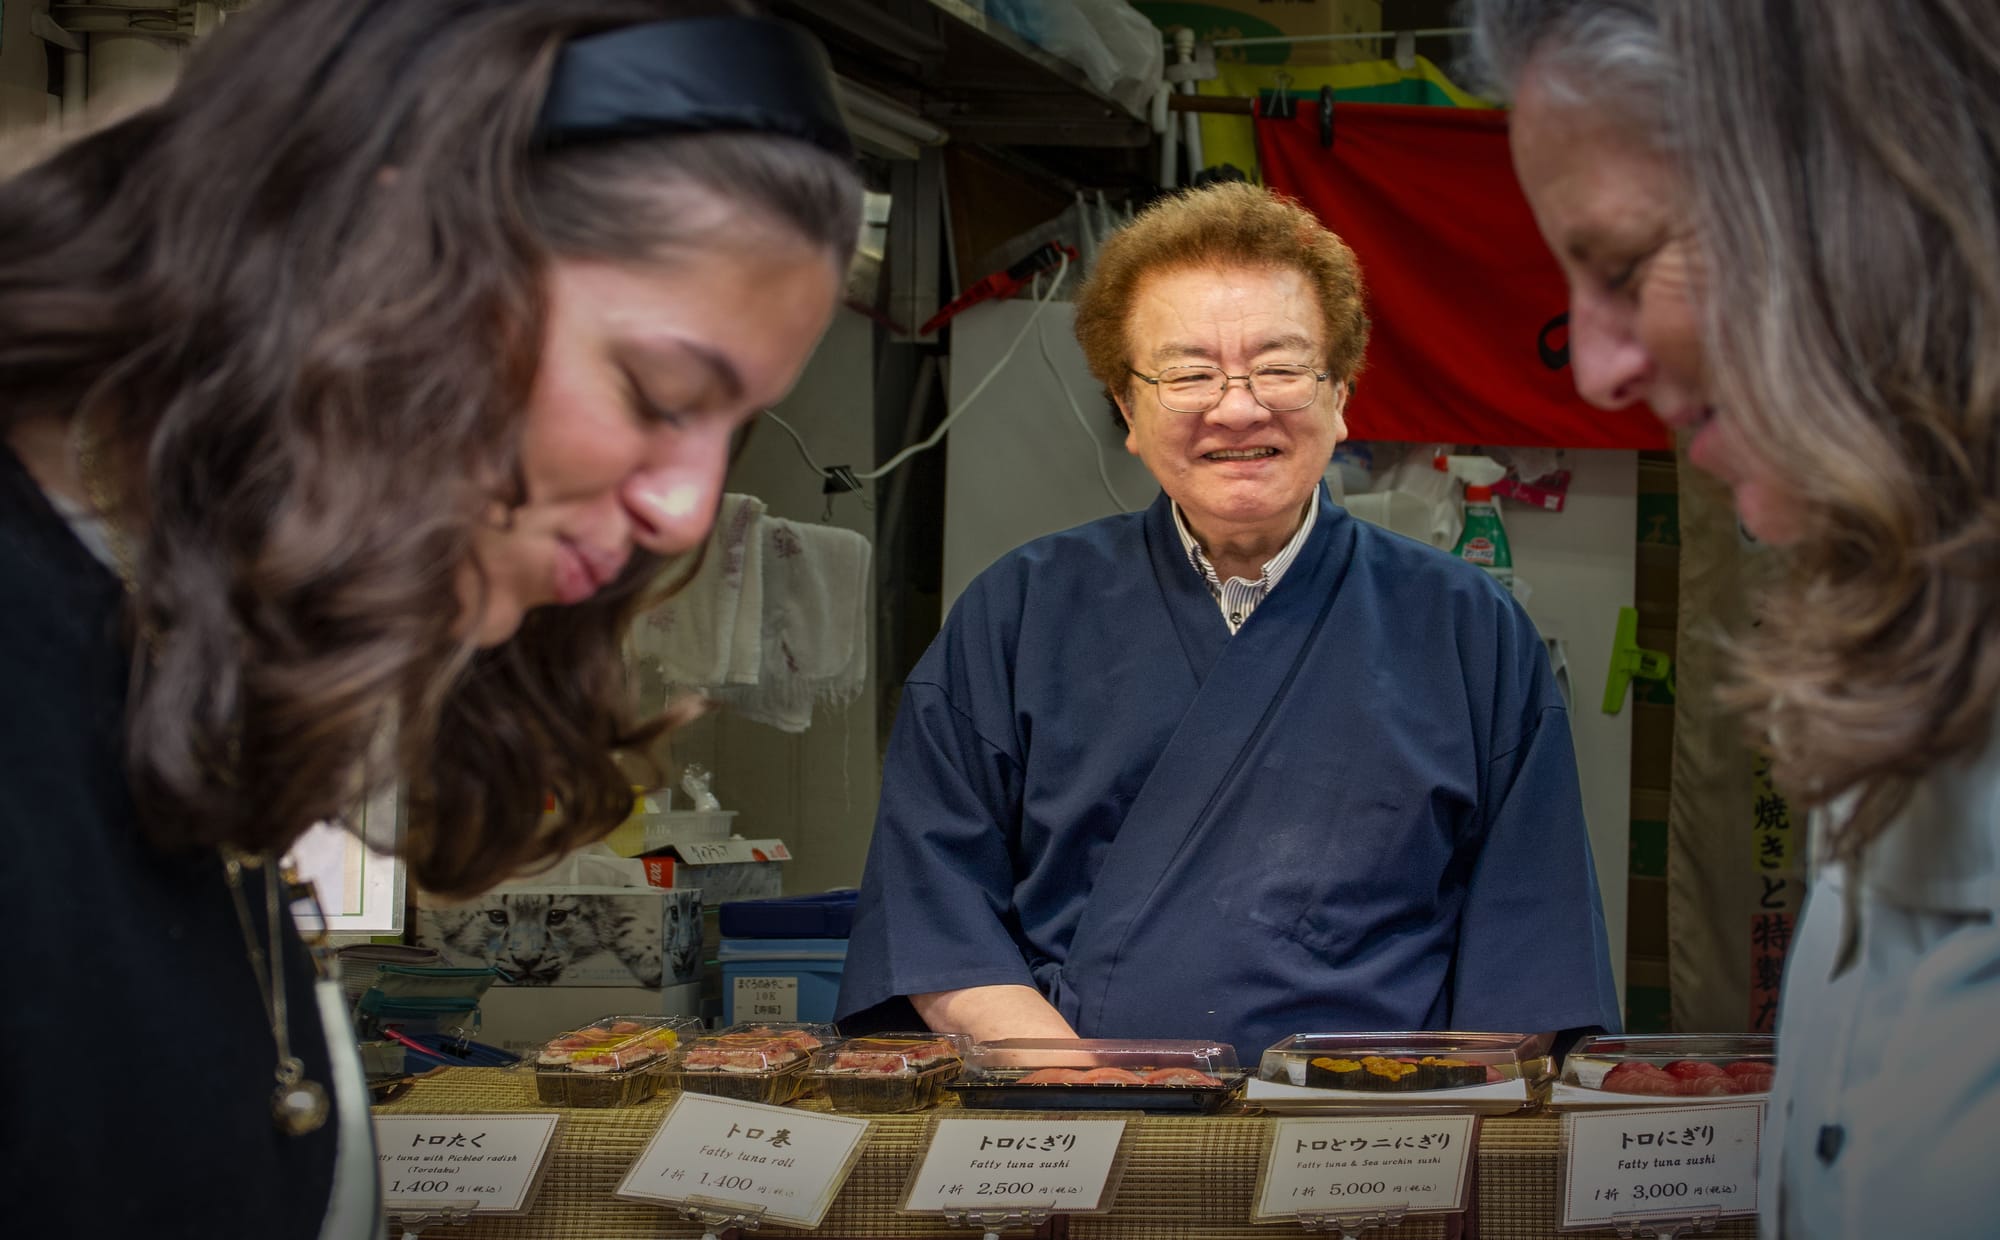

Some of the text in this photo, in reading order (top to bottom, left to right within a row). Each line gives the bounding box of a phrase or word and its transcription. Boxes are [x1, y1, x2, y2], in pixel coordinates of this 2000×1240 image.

[412, 1132, 487, 1148] トロたく
[726, 1122, 793, 1148] トロ巻
[979, 1133, 1077, 1152] トロにぎり
[1295, 1132, 1451, 1153] トロとウニにぎり
[1621, 1125, 1715, 1150] トロにぎり
[376, 1154, 518, 1162] tty tuna with Pickled radish
[698, 1145, 796, 1168] Fatty tuna roll
[1296, 1161, 1321, 1169] Fatty
[1362, 1159, 1379, 1167] Sea
[1382, 1158, 1413, 1166] urchin
[1417, 1157, 1442, 1165] sushi
[1617, 1154, 1716, 1170] Fatty tuna sushi
[407, 1166, 461, 1174] (Torotaku)
[969, 1160, 1071, 1170] Fatty tuna sushi
[389, 1180, 449, 1193] 1,400
[697, 1172, 753, 1191] 1,400
[976, 1182, 1034, 1196] 2,500
[1329, 1181, 1386, 1197] 5,000
[1632, 1182, 1688, 1200] 3,000
